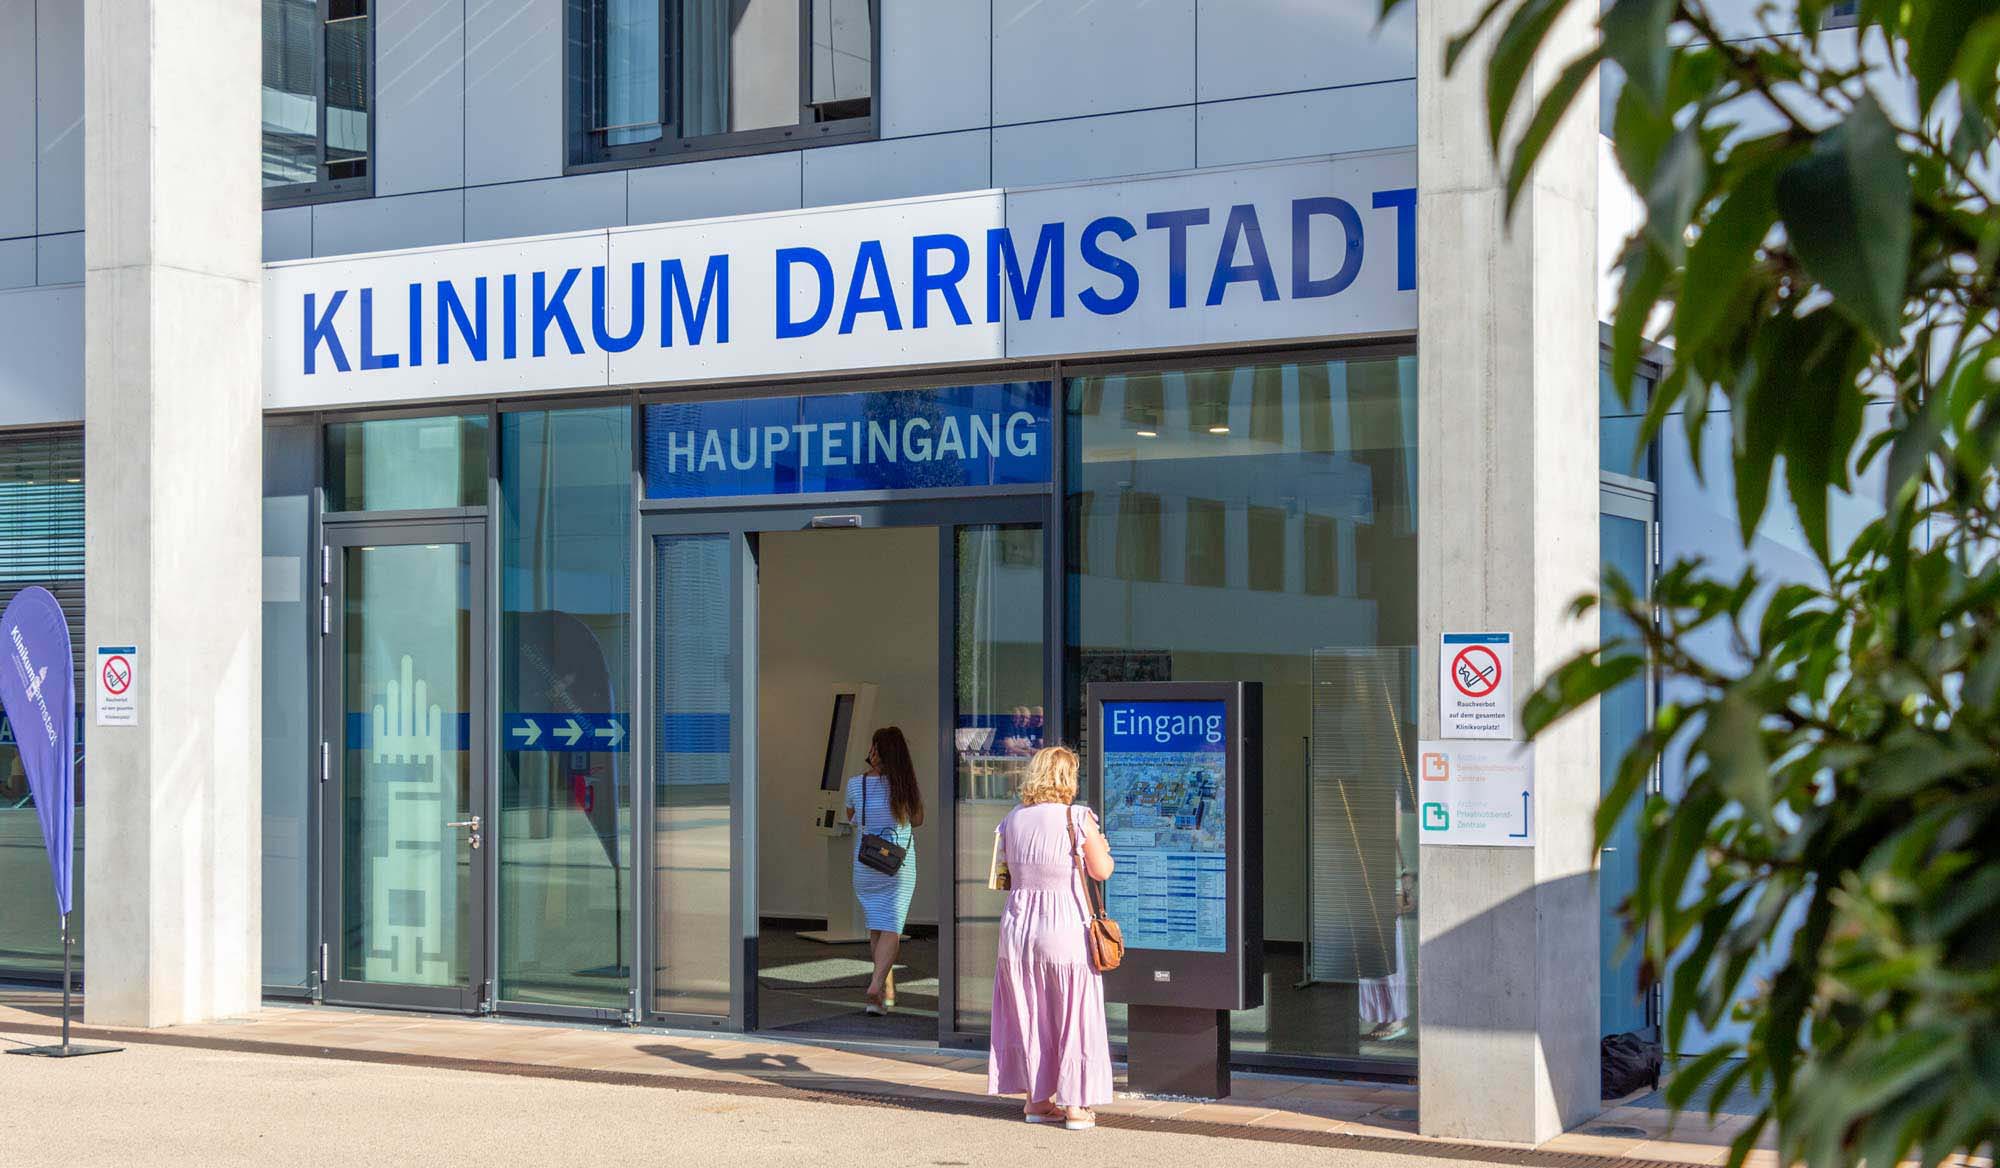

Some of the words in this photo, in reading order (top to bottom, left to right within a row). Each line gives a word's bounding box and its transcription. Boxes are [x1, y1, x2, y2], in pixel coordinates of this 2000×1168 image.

[303, 254, 729, 376] KLINIKUM
[775, 187, 1417, 340] DARMSTADT
[668, 411, 1039, 474] HAUPTEINGANG
[10, 625, 36, 683] Klinikum
[1113, 708, 1222, 743] Eingang
[1475, 712, 1506, 720] gesamten
